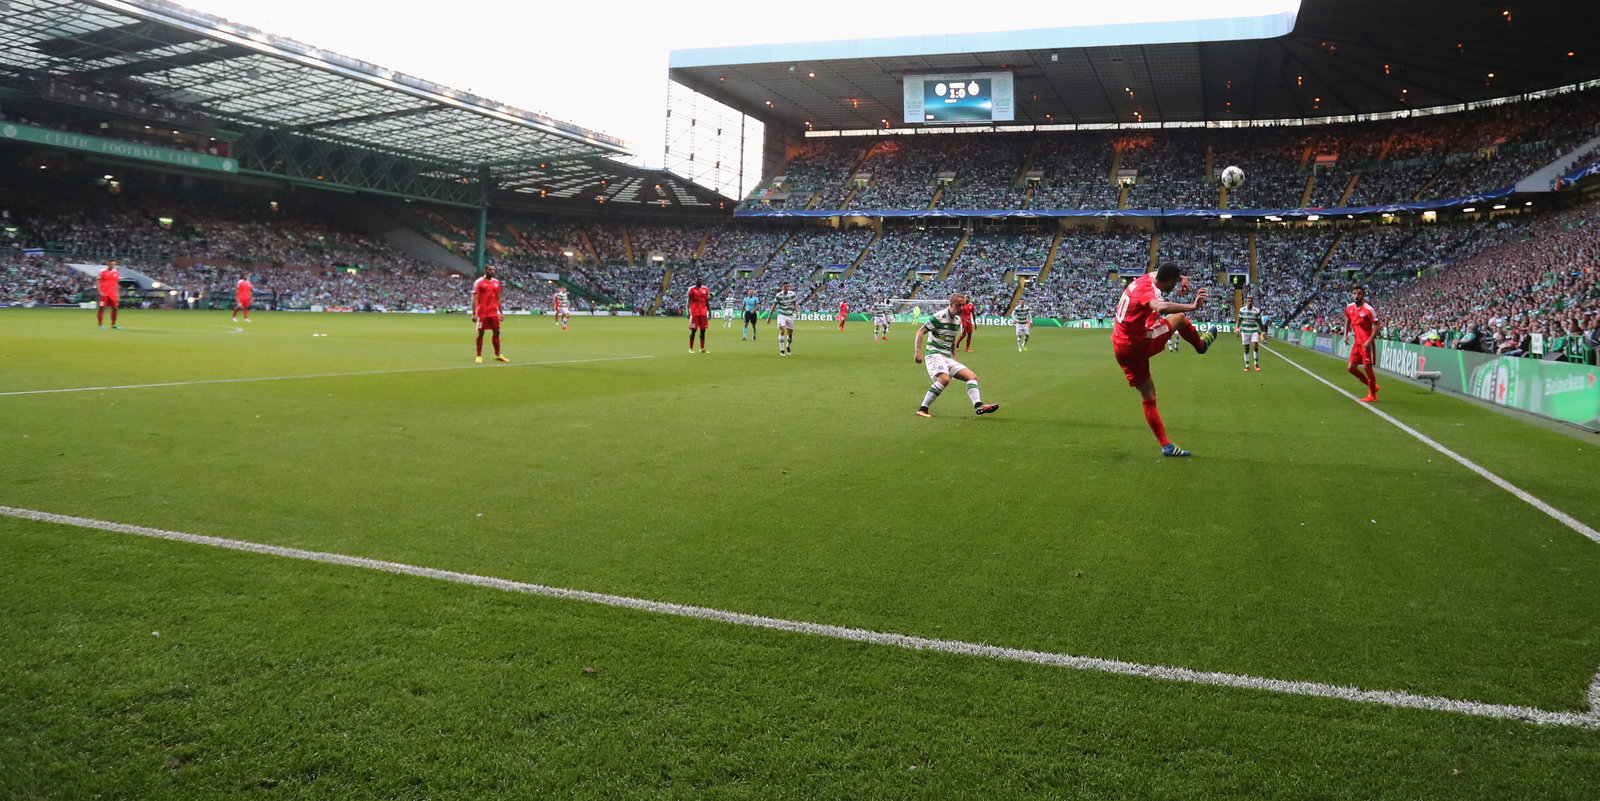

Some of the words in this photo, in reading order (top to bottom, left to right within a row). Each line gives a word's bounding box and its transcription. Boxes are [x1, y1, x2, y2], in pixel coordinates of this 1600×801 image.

[949, 88, 966, 99] 1:0
[44, 133, 89, 148] CELTIC
[102, 142, 161, 160] FOOTBALL
[168, 151, 199, 165] CLUB
[792, 311, 833, 321] eineken
[971, 316, 1014, 326] eineke
[1192, 322, 1231, 332] neken
[1380, 339, 1417, 377] Heineken
[1545, 374, 1585, 396] Heineken
